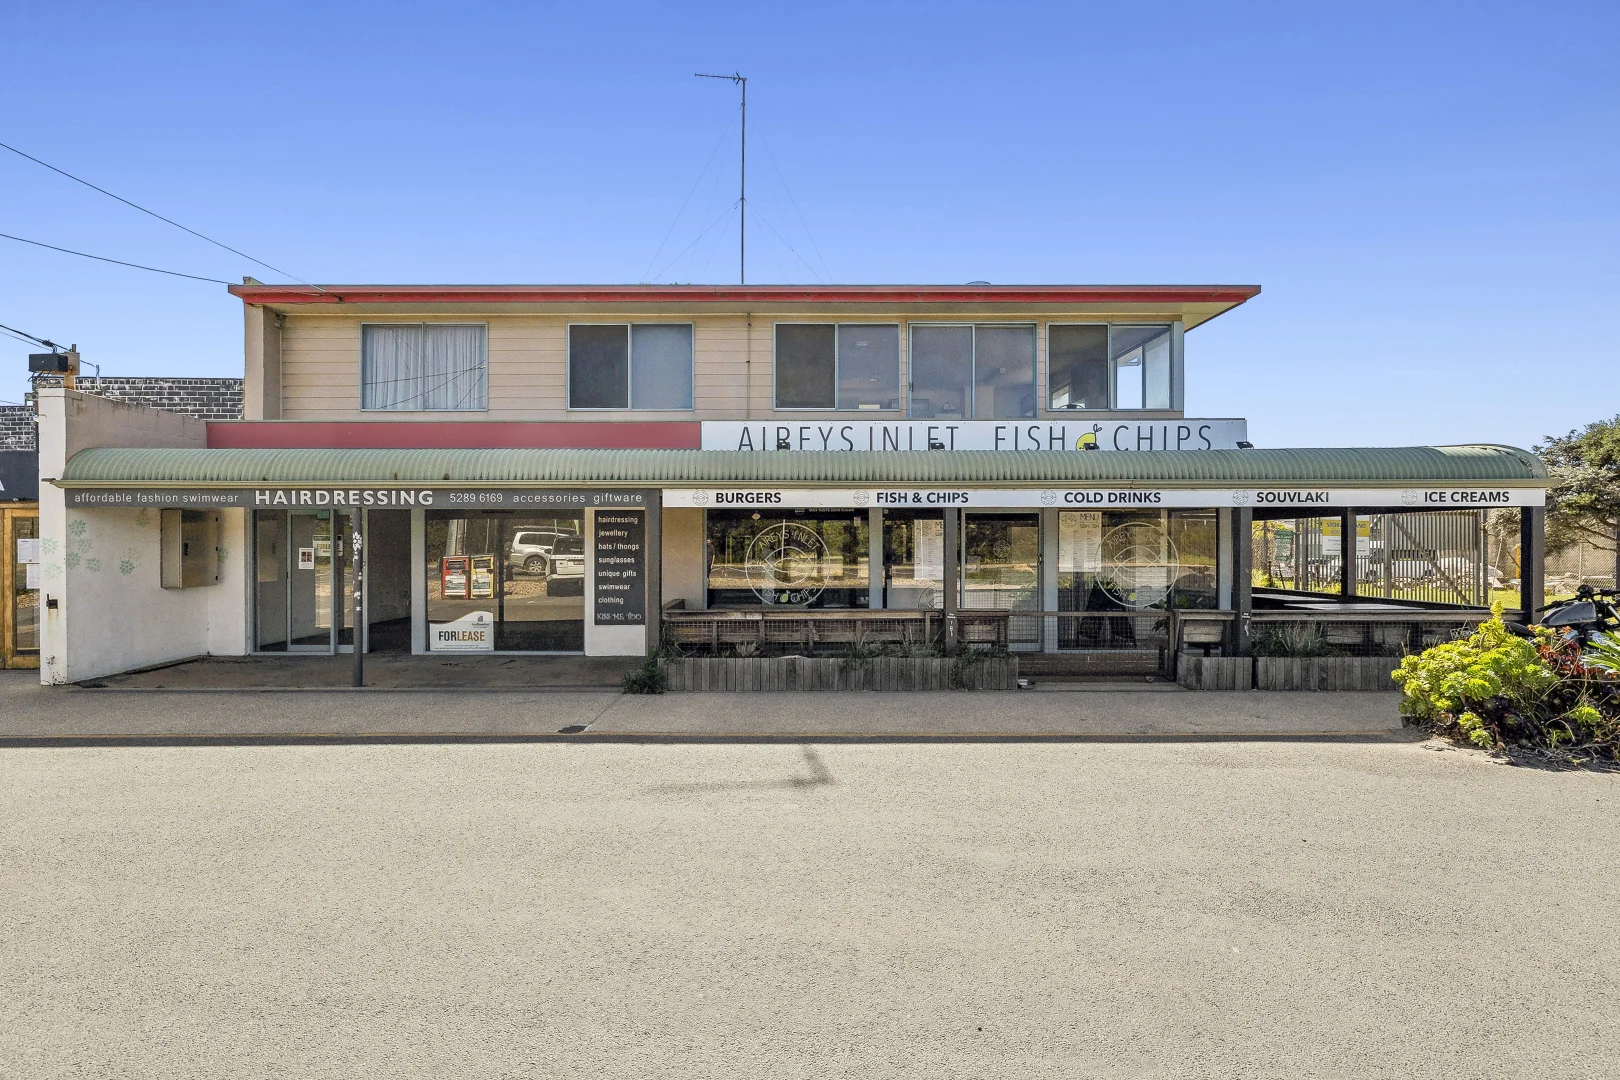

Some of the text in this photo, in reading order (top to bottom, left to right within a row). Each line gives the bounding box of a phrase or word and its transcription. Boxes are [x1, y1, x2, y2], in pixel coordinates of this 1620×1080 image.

[994, 425, 1066, 450] FISH
[1113, 425, 1212, 450] CHIPS
[74, 490, 642, 505] affordable fashion swimwear HAIRDRESSING 5289 6169 accessories giftware
[715, 492, 782, 504] BURGERS
[876, 492, 908, 504] FISH
[912, 492, 923, 504] &
[926, 492, 969, 504] CHIPS
[1064, 492, 1104, 504] COLD
[1108, 492, 1161, 503] DRINKS
[1256, 491, 1330, 503] SOUVLAKI
[1424, 491, 1447, 503] ICE
[1450, 491, 1510, 503] CREAMS
[598, 516, 639, 525] hairdressing
[598, 529, 629, 538] jewellery
[617, 543, 640, 551] thongs
[598, 557, 635, 565] sunglasses
[598, 570, 637, 578] unique gifts
[598, 596, 624, 604] clothing
